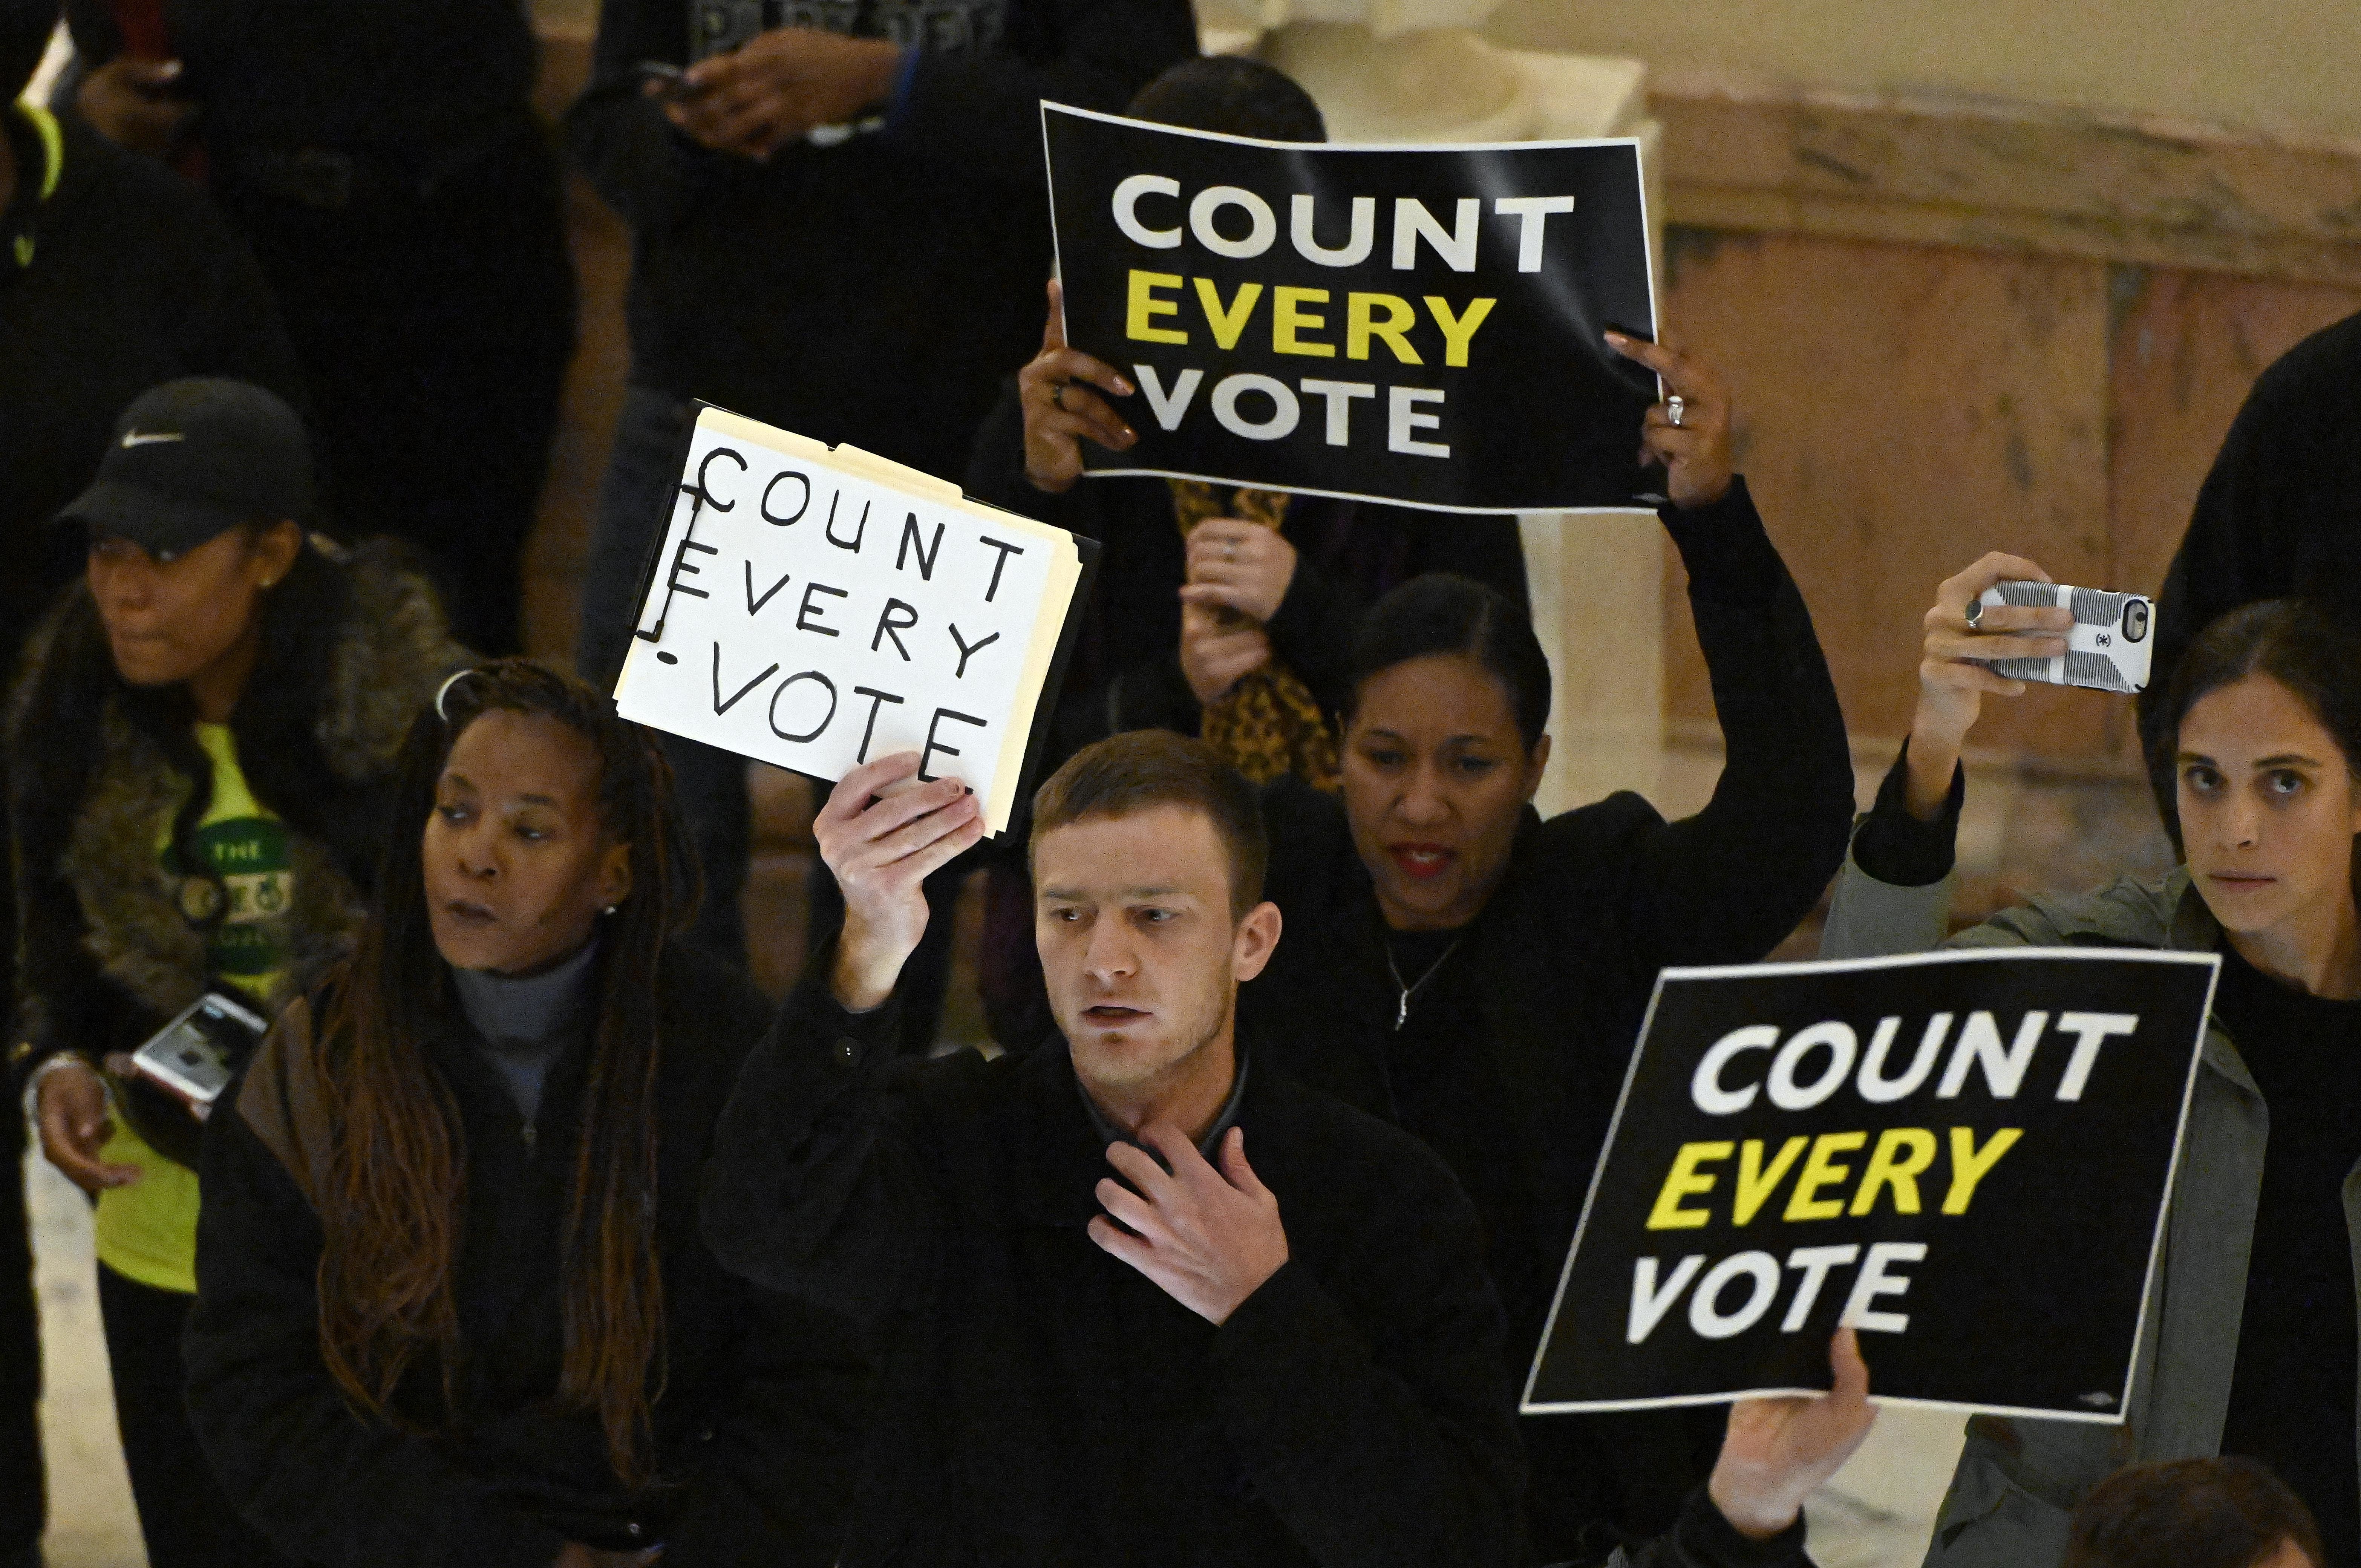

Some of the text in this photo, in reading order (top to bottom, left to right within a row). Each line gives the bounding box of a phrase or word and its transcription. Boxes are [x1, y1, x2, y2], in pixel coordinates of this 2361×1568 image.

[1112, 174, 1575, 273] COUNT
[1125, 268, 1497, 368] EVERY
[1133, 364, 1451, 459] VOTE
[697, 446, 1025, 602] COUNT
[667, 538, 1000, 679] EVERY
[712, 641, 988, 795] VOTE
[1690, 1010, 2139, 1115] COUNT
[1646, 1126, 2023, 1230] EVERY
[1626, 1242, 1928, 1344] VOTE
